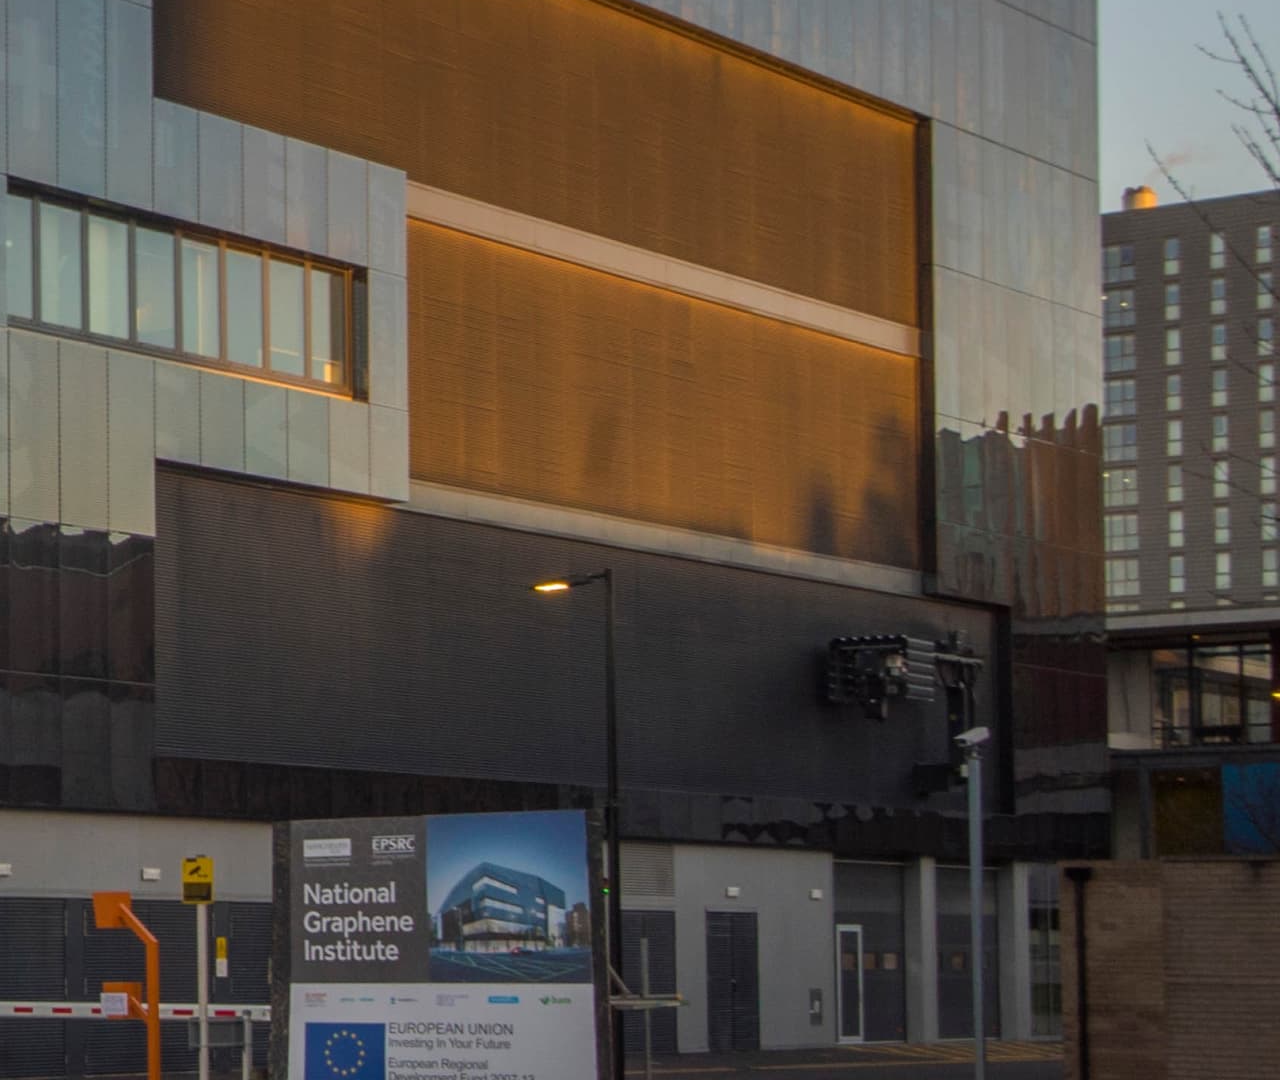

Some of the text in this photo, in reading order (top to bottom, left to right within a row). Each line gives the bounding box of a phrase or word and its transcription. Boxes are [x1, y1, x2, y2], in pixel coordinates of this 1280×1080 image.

[372, 837, 416, 851] EPSRC
[303, 881, 396, 905] National
[303, 910, 415, 938] Graphene
[303, 939, 400, 961] Institute
[389, 1022, 514, 1035] EUROPEAN UNION
[389, 1037, 434, 1050] Investing
[448, 1037, 474, 1049] Your
[475, 1038, 512, 1049] Future
[388, 1057, 488, 1072] European Regional
